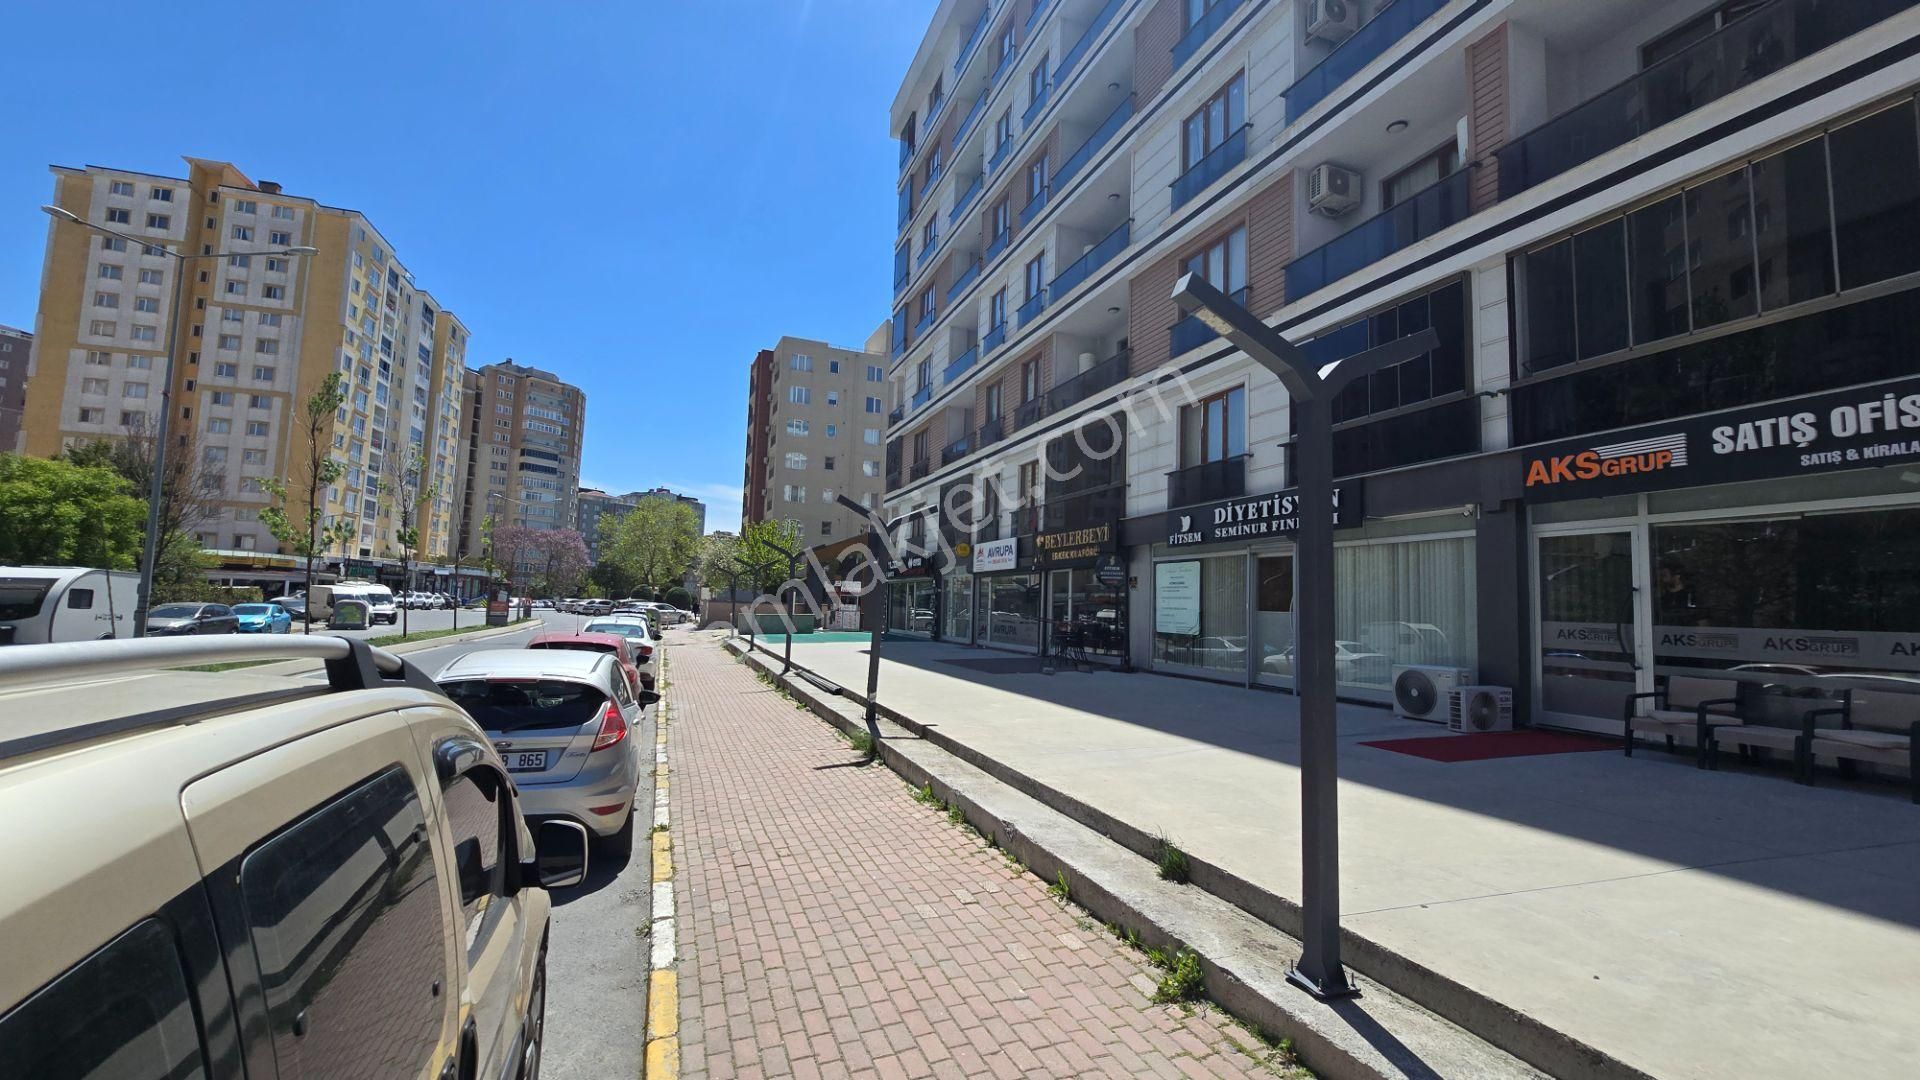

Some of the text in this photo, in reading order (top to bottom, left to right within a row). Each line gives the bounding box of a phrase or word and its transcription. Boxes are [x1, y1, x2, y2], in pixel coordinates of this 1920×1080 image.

[1712, 393, 1920, 454] SATIŞ OFİS
[1801, 450, 1842, 467] SATIŞ
[1846, 449, 1860, 461] &
[1214, 489, 1340, 525] DİYETİSN
[1045, 522, 1109, 550] BEYLERBEYİ
[1214, 522, 1267, 538] SEMİNUR
[987, 544, 1014, 558] AVRUPA
[518, 753, 543, 767] 865
